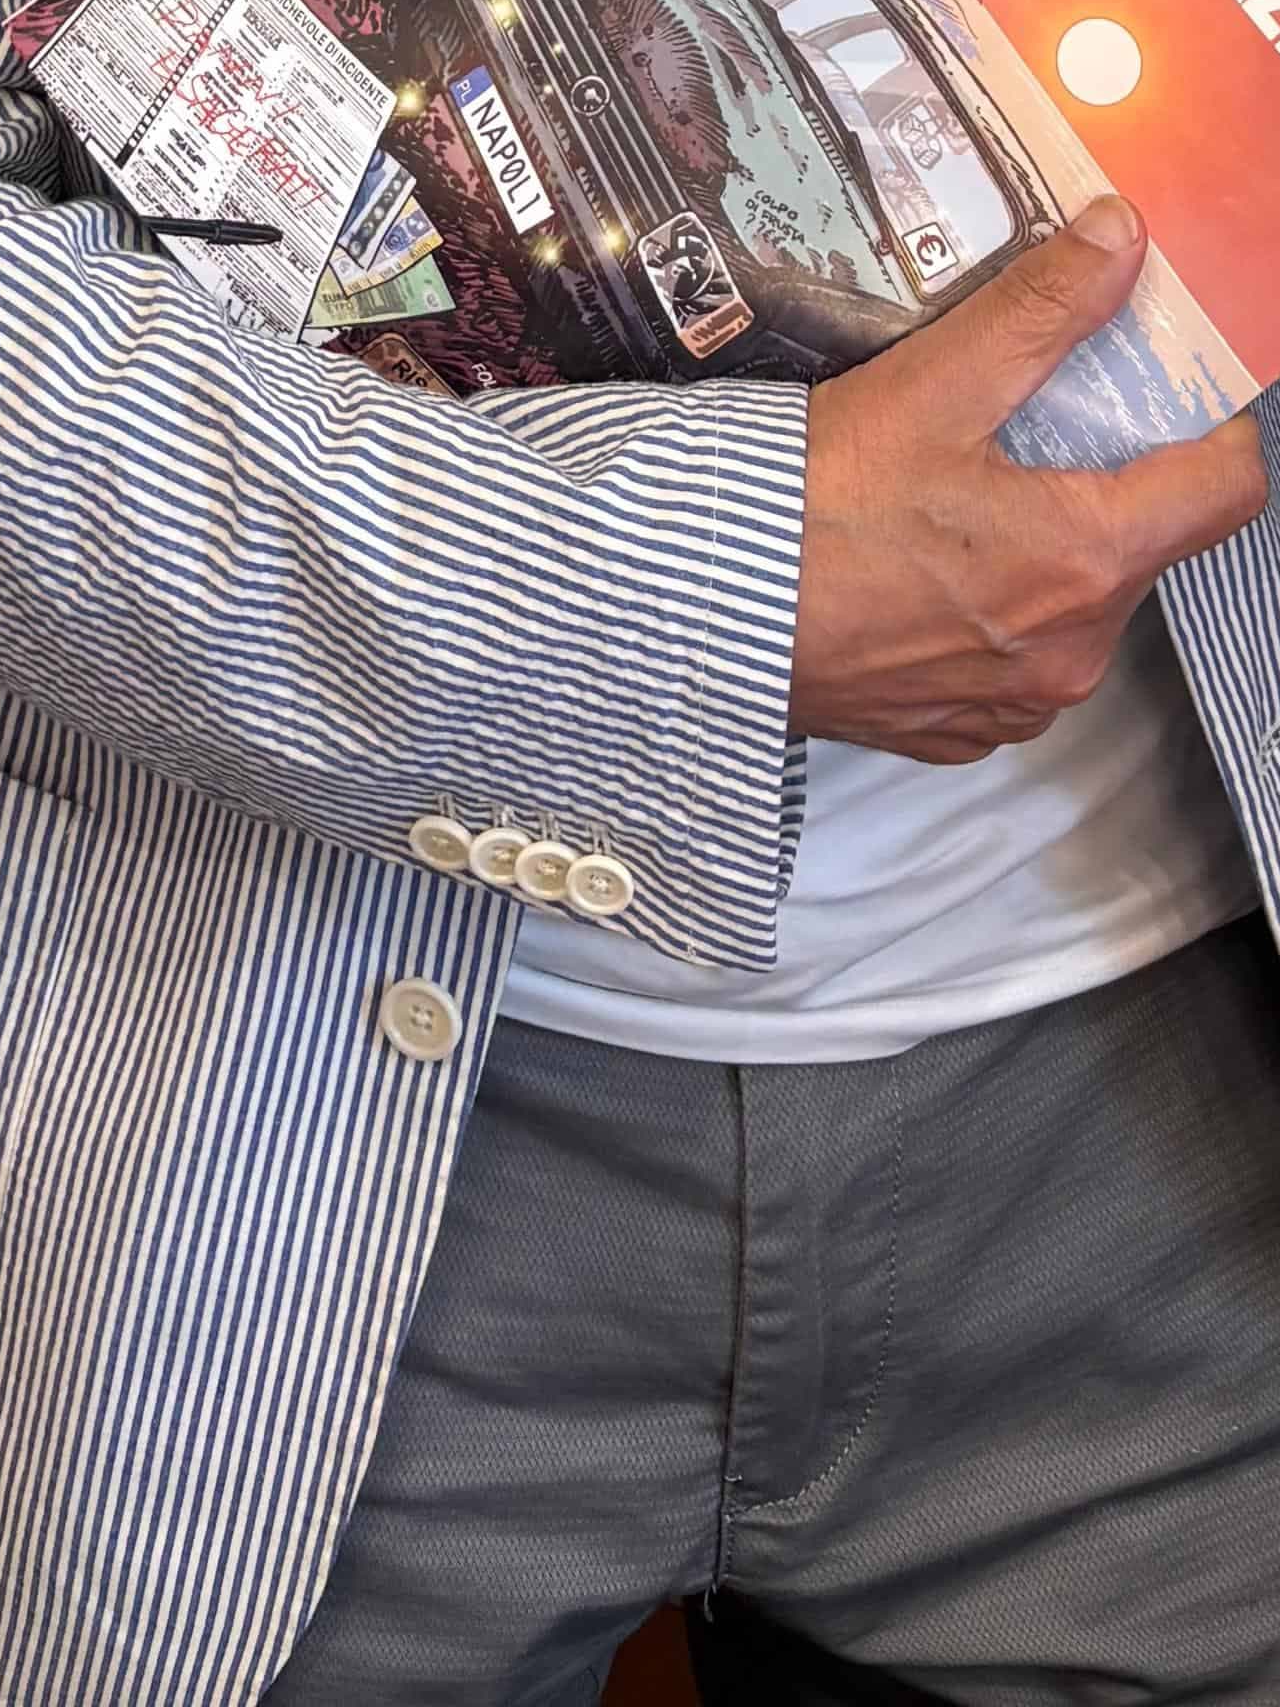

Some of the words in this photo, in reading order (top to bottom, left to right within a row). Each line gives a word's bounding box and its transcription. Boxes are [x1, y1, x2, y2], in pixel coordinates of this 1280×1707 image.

[324, 40, 339, 57] DI
[335, 53, 389, 109] INCIDENTE
[471, 96, 541, 215] NAPOLI
[745, 198, 759, 213] DI
[761, 209, 806, 245] FRUSTA
[753, 189, 799, 222] COLPO
